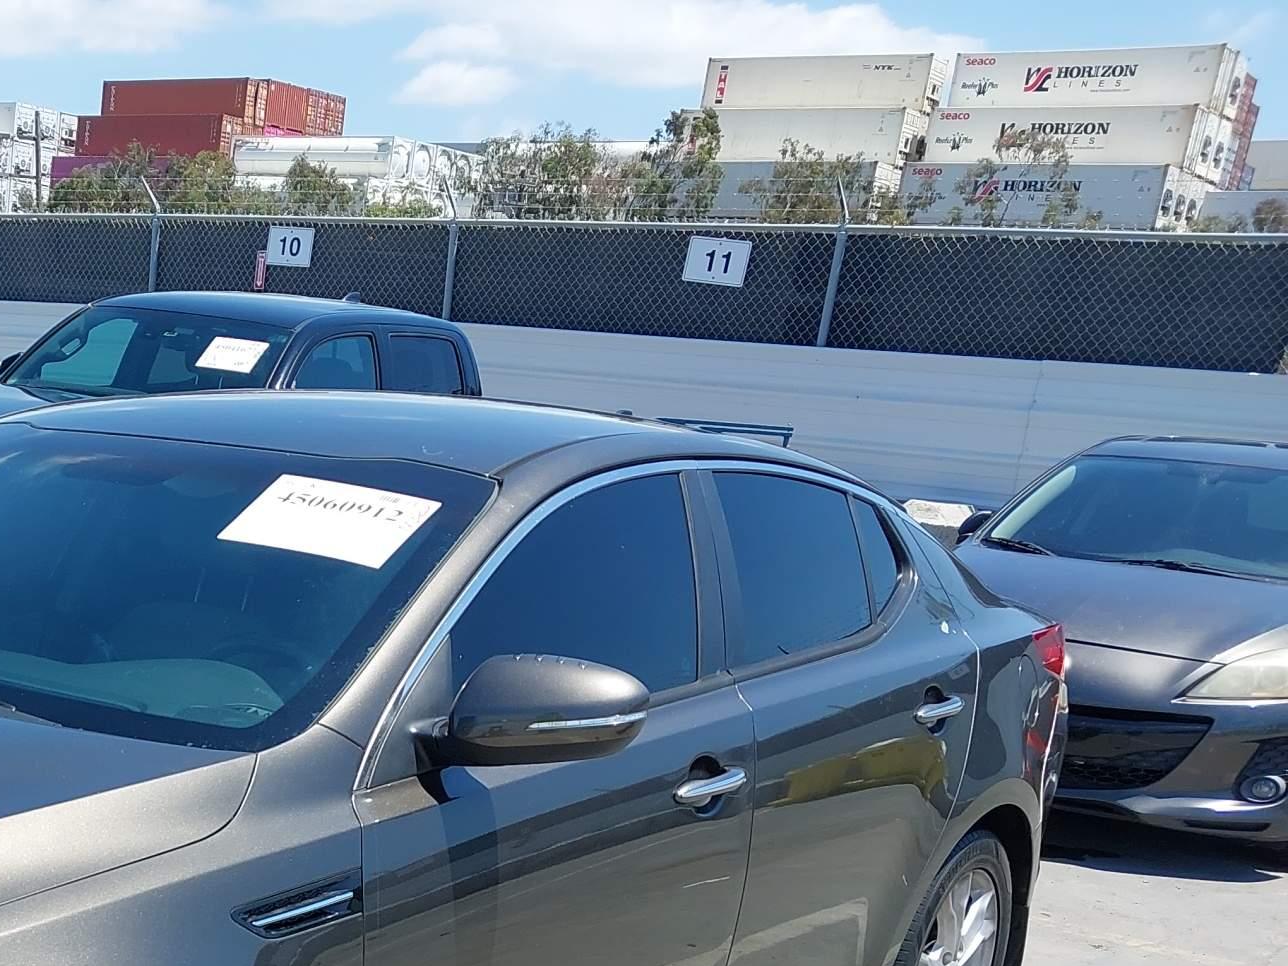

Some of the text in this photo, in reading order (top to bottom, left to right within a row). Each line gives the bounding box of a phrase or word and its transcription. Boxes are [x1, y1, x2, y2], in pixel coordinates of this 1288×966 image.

[965, 57, 996, 66] seaco
[1055, 64, 1139, 79] HORIZON
[938, 112, 970, 120] seaco
[1030, 122, 1111, 135] HORIZON
[279, 236, 301, 257] 10
[705, 249, 732, 274] 11
[277, 491, 404, 522] 45060912
